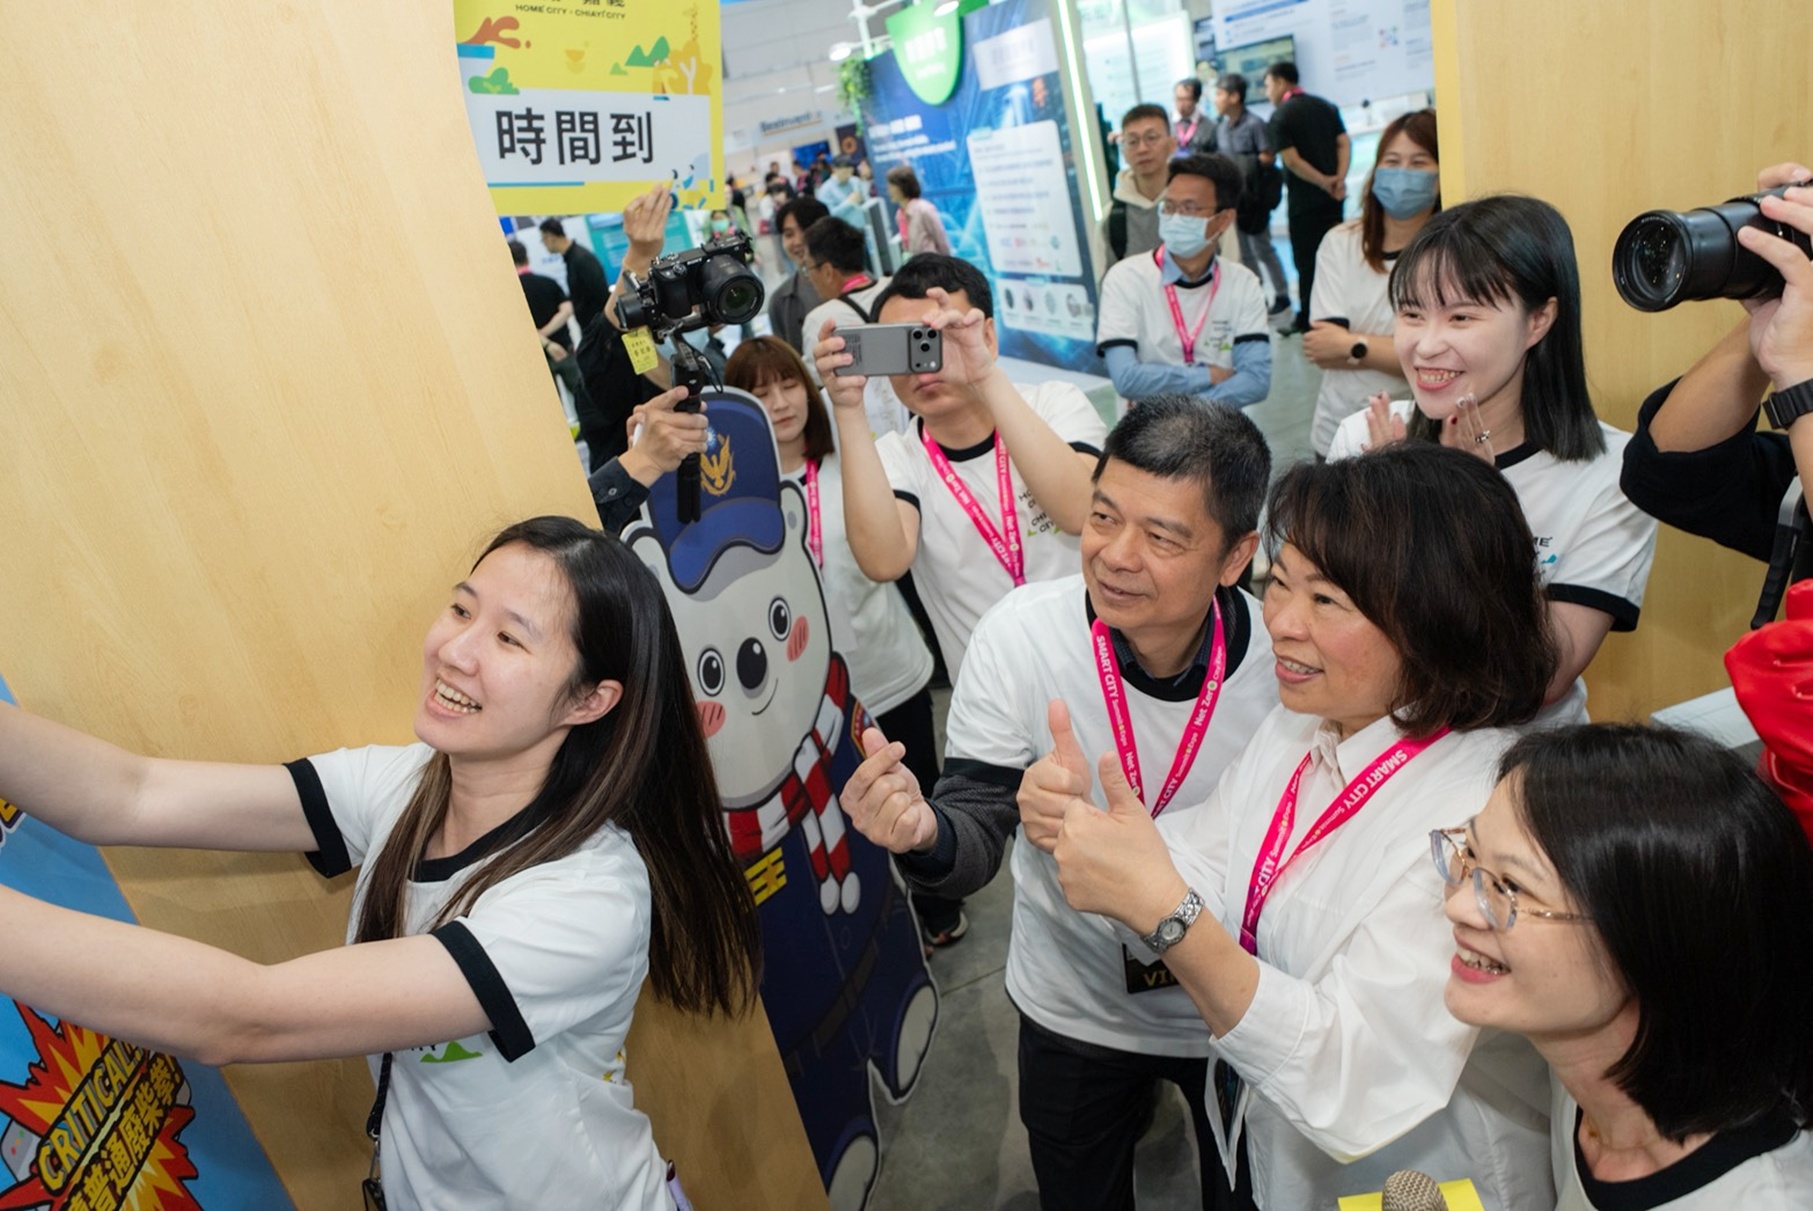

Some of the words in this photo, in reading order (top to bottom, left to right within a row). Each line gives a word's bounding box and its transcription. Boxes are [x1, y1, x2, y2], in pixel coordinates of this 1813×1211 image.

[495, 107, 653, 165] 時間到
[1096, 635, 1113, 672] SMART
[1104, 675, 1118, 698] CITY
[1125, 752, 1134, 770] Net
[1163, 778, 1179, 801] CITY
[1194, 708, 1207, 727] Net
[1366, 749, 1408, 789] SMART
[1343, 785, 1369, 810] CITY
[1258, 859, 1276, 887] CITY
[1143, 970, 1176, 987] VI
